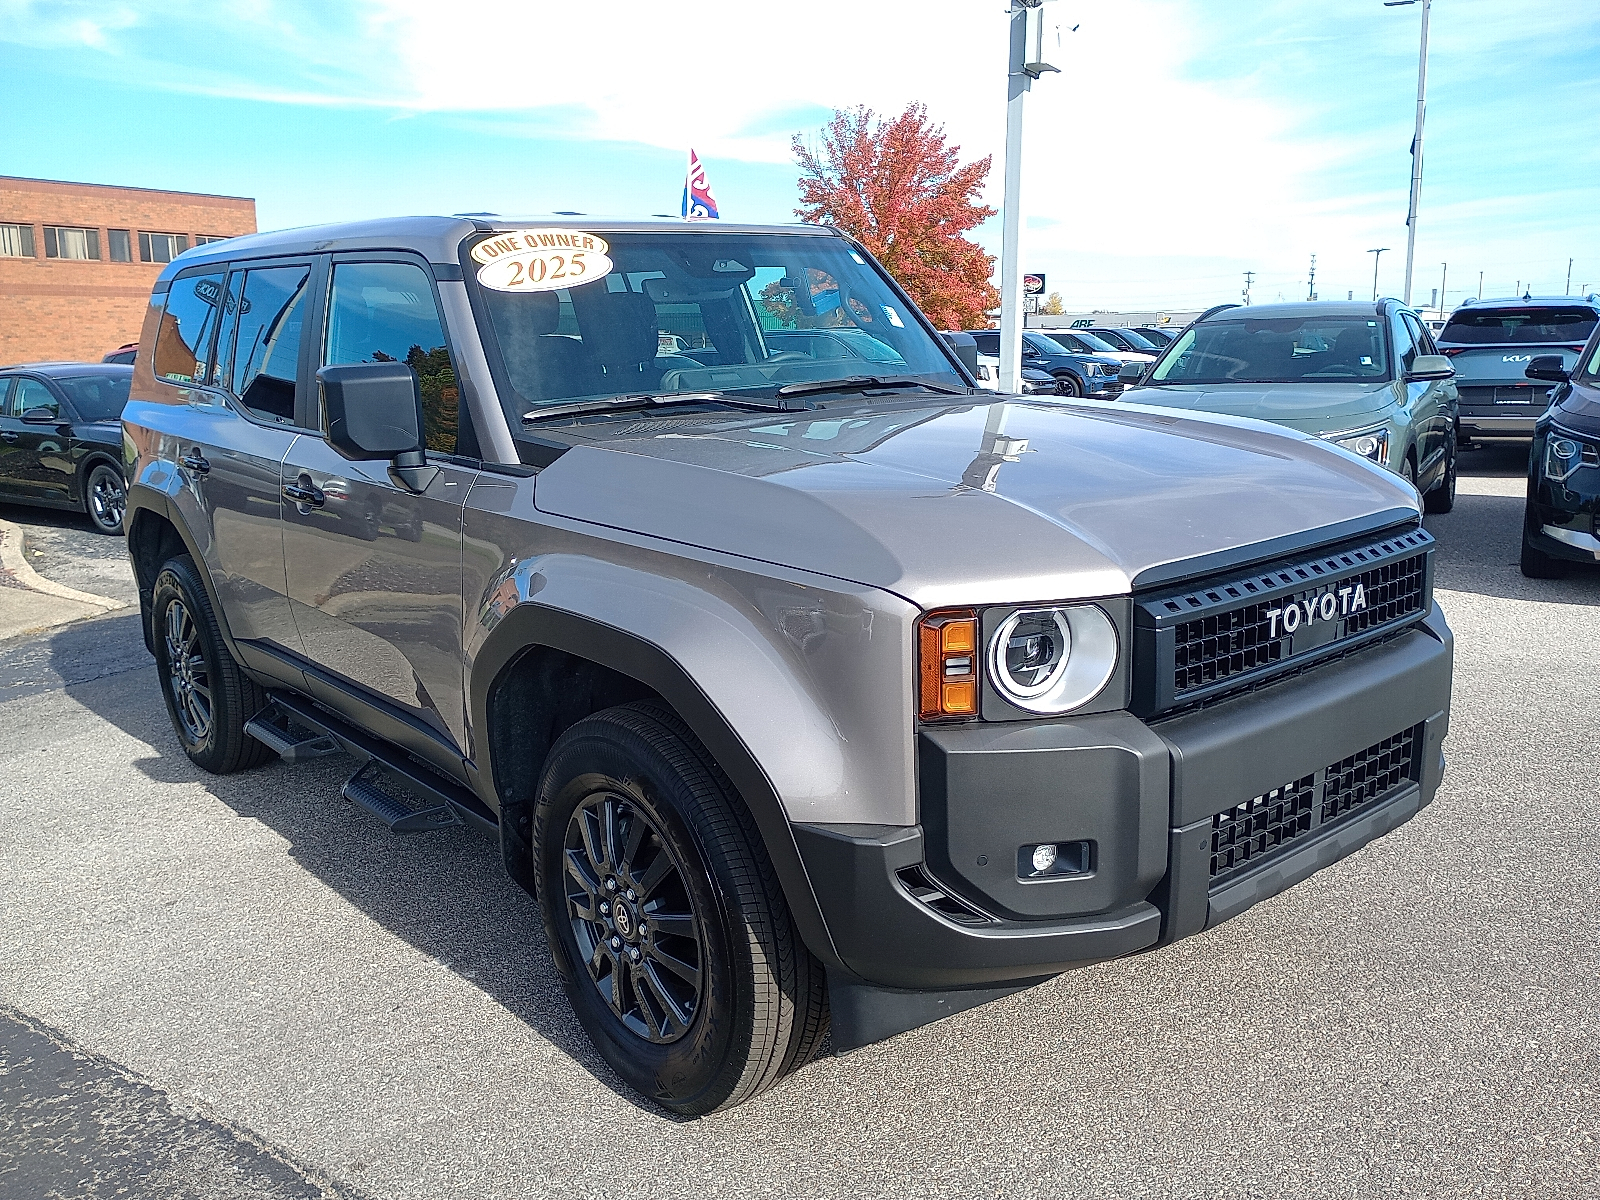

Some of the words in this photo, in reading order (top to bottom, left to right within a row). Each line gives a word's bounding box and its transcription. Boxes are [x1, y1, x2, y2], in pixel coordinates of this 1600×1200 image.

[481, 237, 522, 258] ONE
[525, 233, 594, 250] OWNER
[507, 253, 586, 286] 2025
[1266, 583, 1367, 639] TOYOTA
